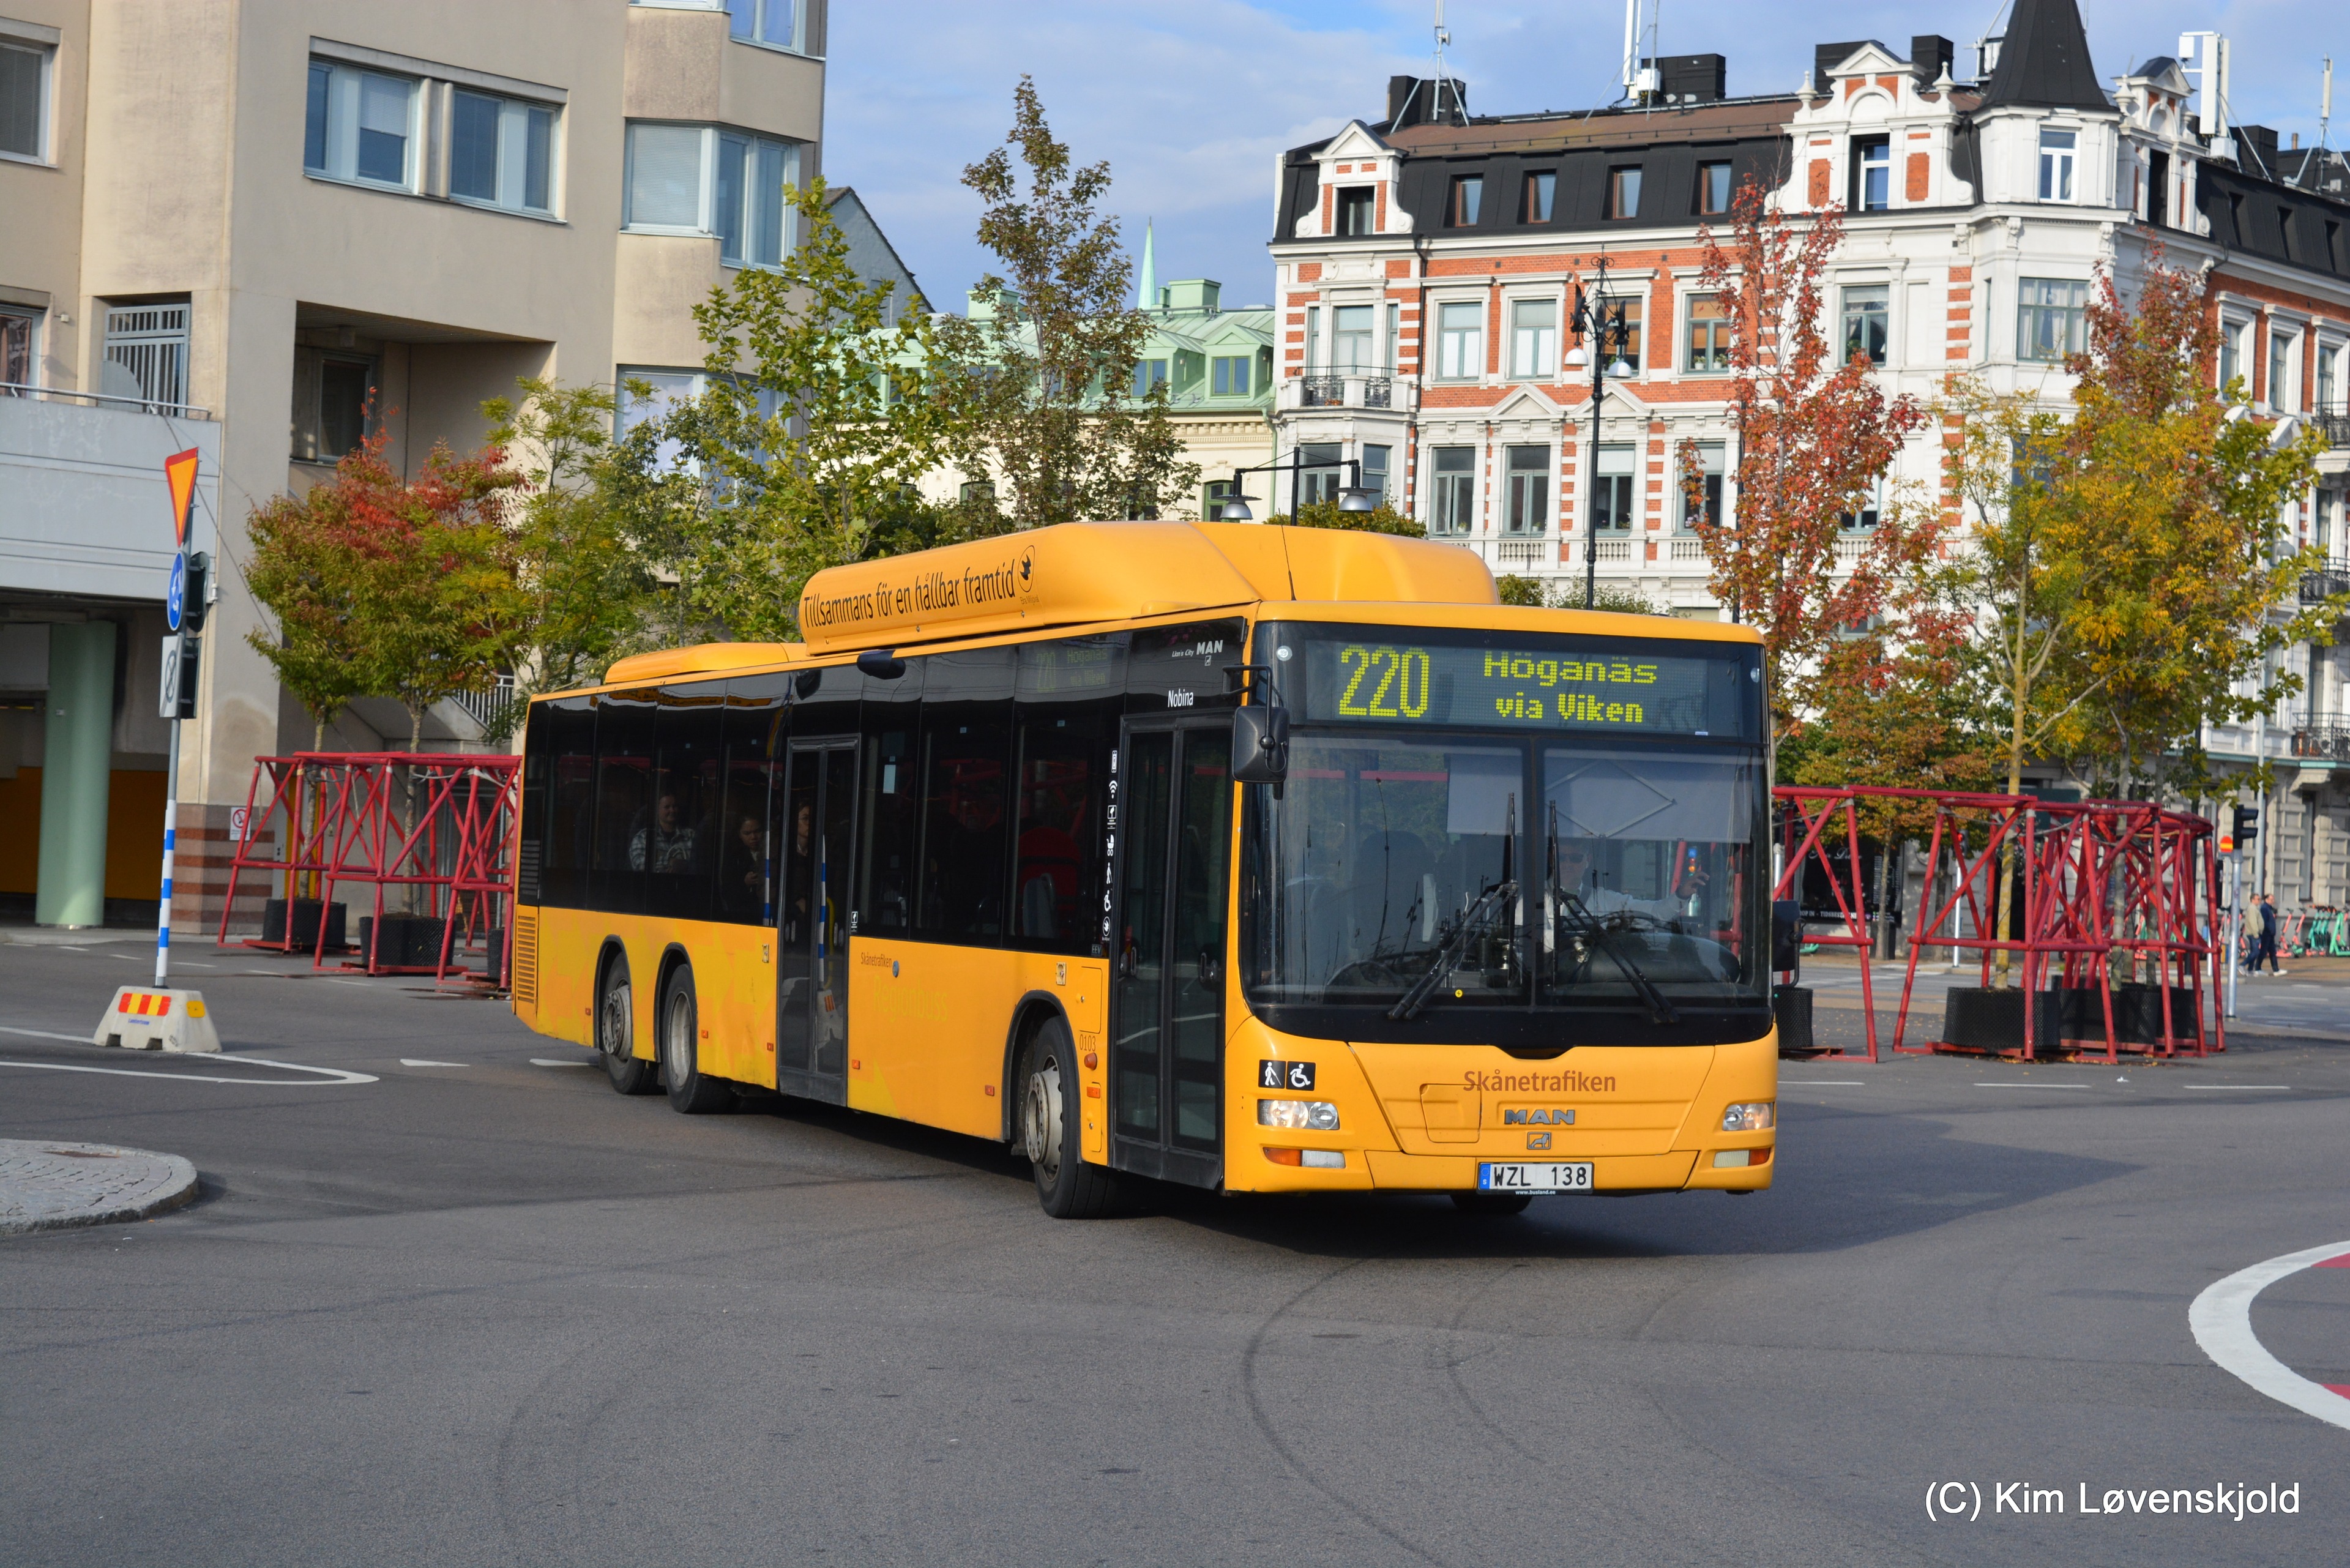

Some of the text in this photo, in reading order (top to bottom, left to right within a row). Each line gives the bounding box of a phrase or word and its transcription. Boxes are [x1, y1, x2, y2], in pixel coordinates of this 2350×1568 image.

[804, 559, 1016, 628] Tillsammans för en hållbar framtid
[1196, 640, 1223, 655] MAN
[1483, 651, 1657, 687] Höganäs
[1340, 644, 1430, 718] 220
[1167, 689, 1194, 707] Nobina
[1496, 692, 1643, 723] via Viken
[1092, 945, 1101, 954] EEV
[860, 952, 892, 968] Skånetrafiken
[873, 975, 949, 1023] Regionbuss
[1079, 1034, 1096, 1051] 0103
[1463, 1069, 1616, 1092] Skånetrafiken
[1504, 1109, 1575, 1125] MAN
[1494, 1167, 1531, 1187] WZL
[1551, 1167, 1587, 1186] 138
